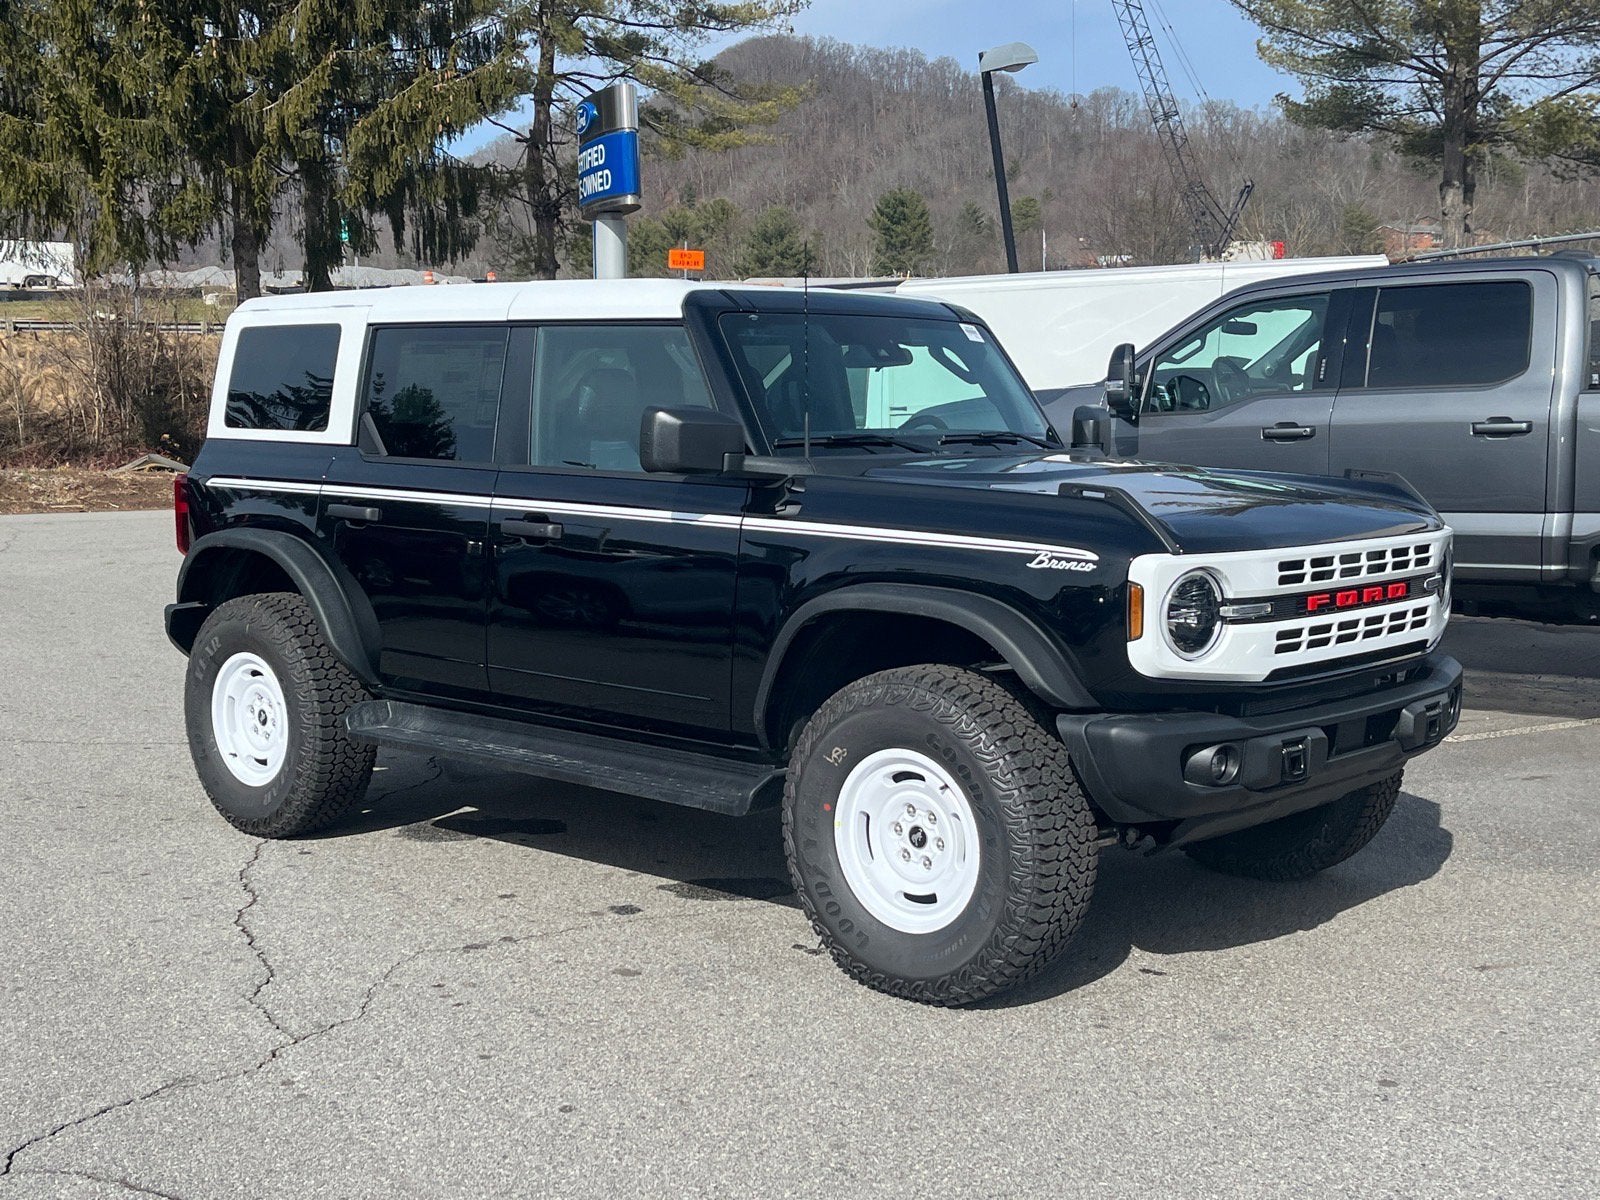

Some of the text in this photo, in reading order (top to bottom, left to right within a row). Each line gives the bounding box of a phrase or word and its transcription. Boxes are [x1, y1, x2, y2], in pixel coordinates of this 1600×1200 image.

[578, 144, 606, 174] ERTIFIED
[578, 169, 612, 200] E-OWNED
[1026, 550, 1097, 572] Bronco
[1308, 582, 1407, 611] FORD
